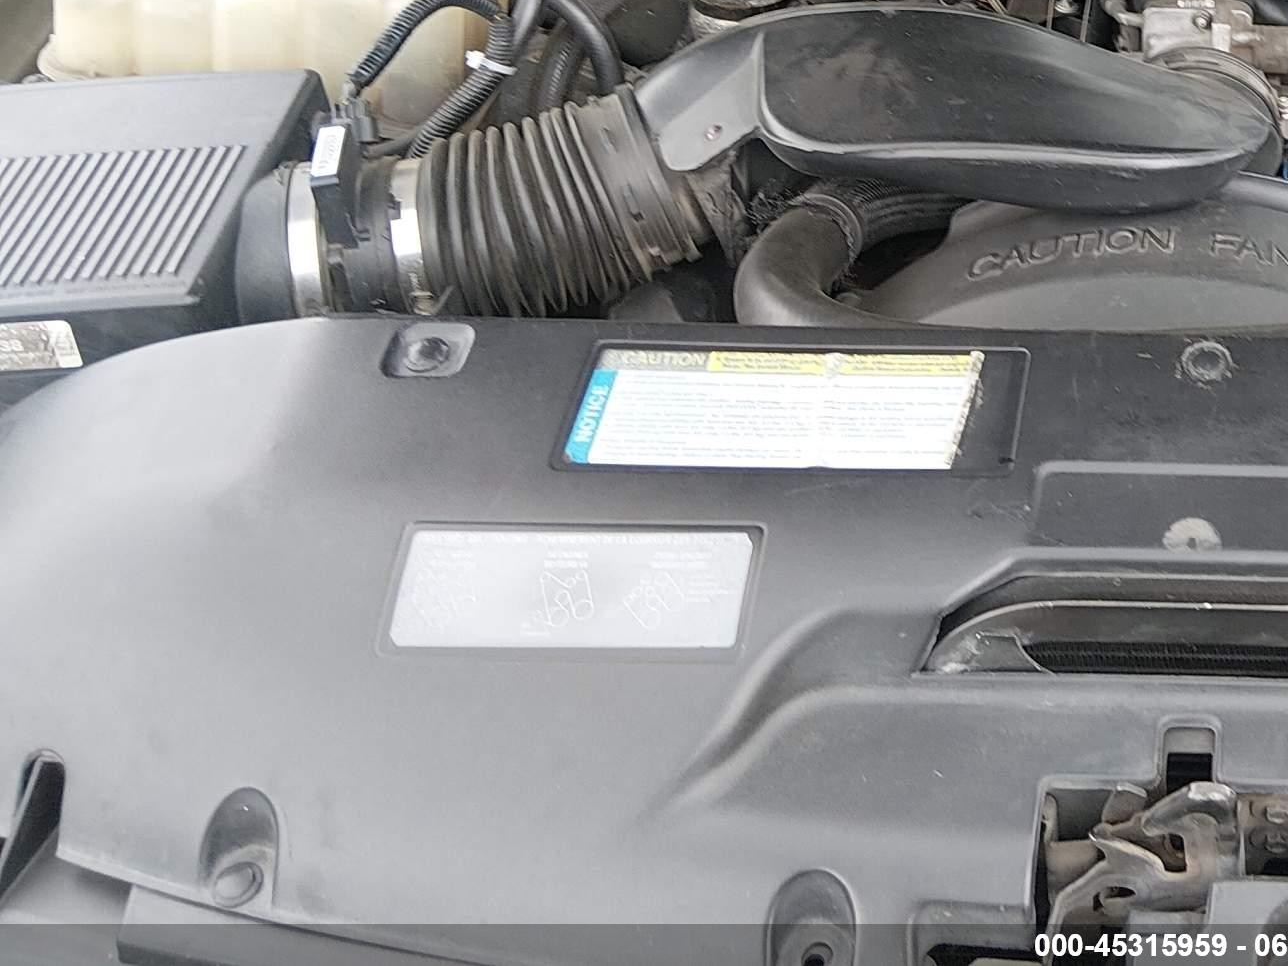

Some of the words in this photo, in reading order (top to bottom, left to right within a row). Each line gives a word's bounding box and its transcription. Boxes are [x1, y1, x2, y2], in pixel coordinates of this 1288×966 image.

[966, 225, 1179, 282] CAUTION
[619, 349, 706, 367] CAUTION
[575, 384, 609, 442] NOTICE
